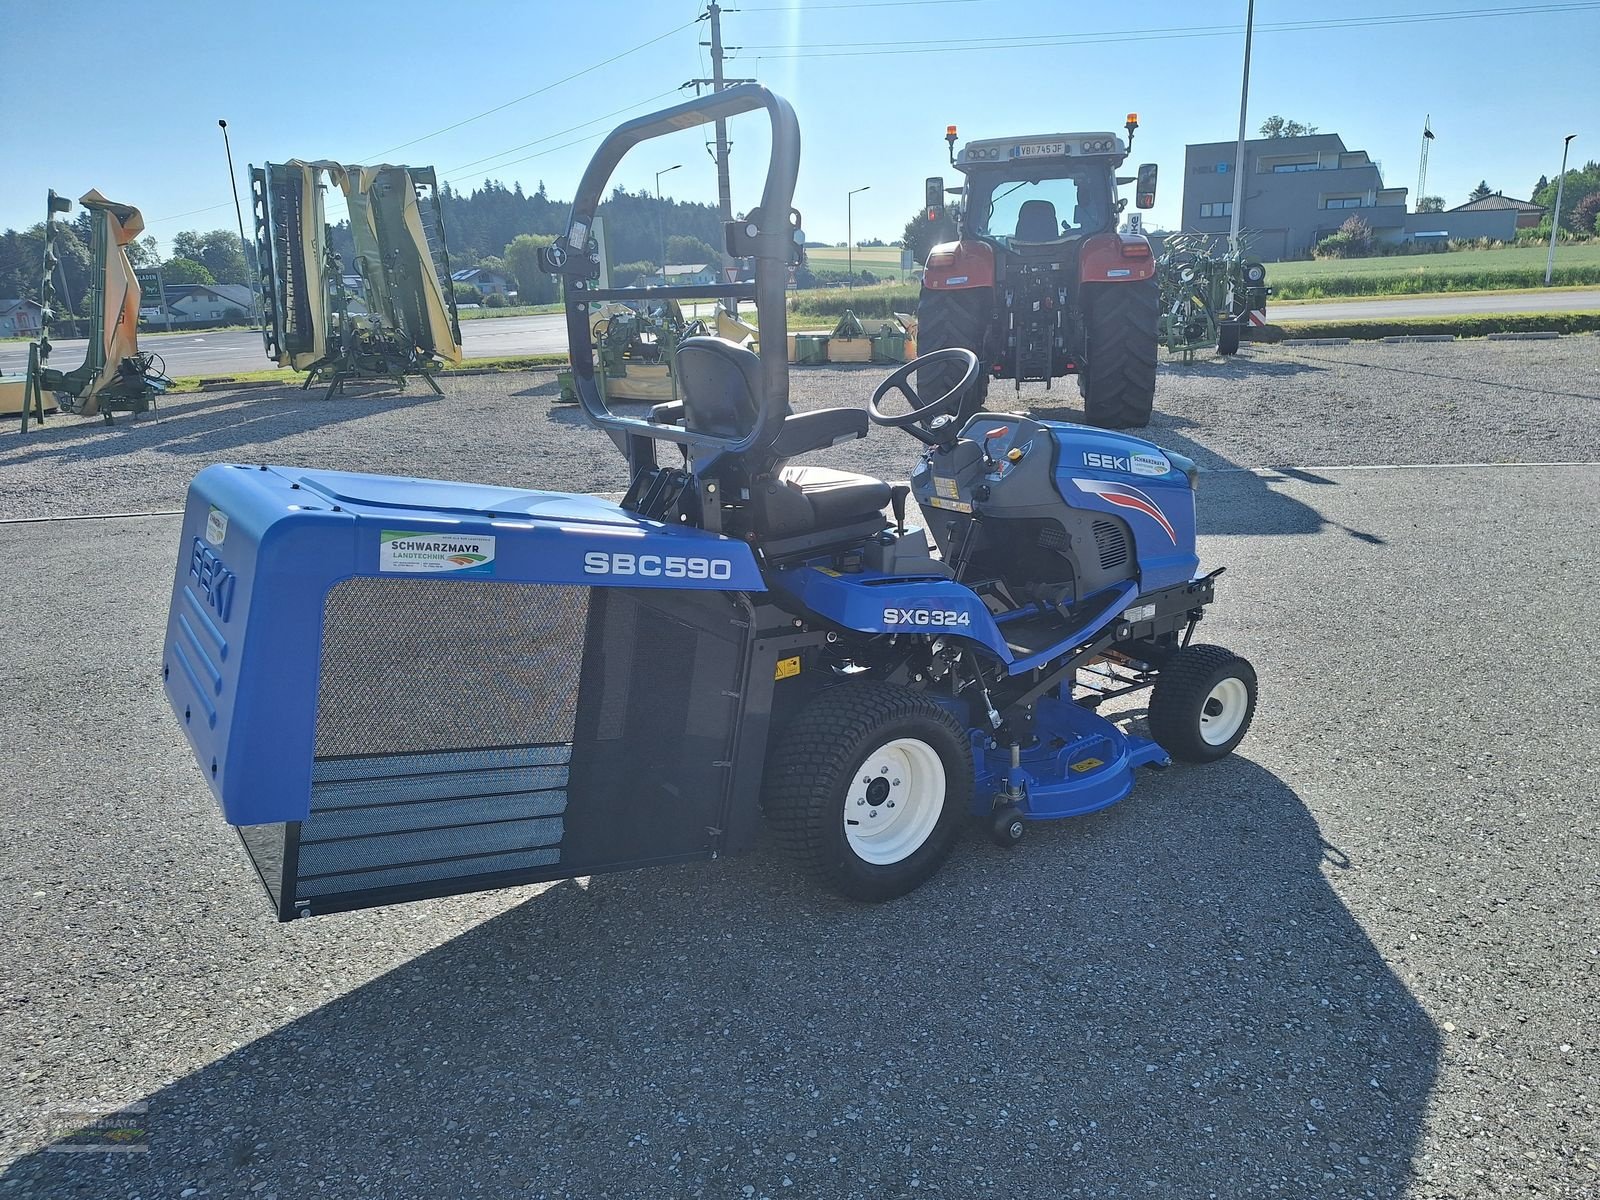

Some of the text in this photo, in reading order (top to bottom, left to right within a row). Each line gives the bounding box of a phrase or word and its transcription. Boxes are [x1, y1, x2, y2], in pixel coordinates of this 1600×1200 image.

[1052, 144, 1062, 153] JF
[1082, 451, 1131, 471] ISEKI
[391, 541, 480, 553] SCHWARZMAYR
[392, 552, 445, 561] LANDTECHNIK
[584, 552, 732, 580] SBC590
[883, 608, 971, 627] SXG324
